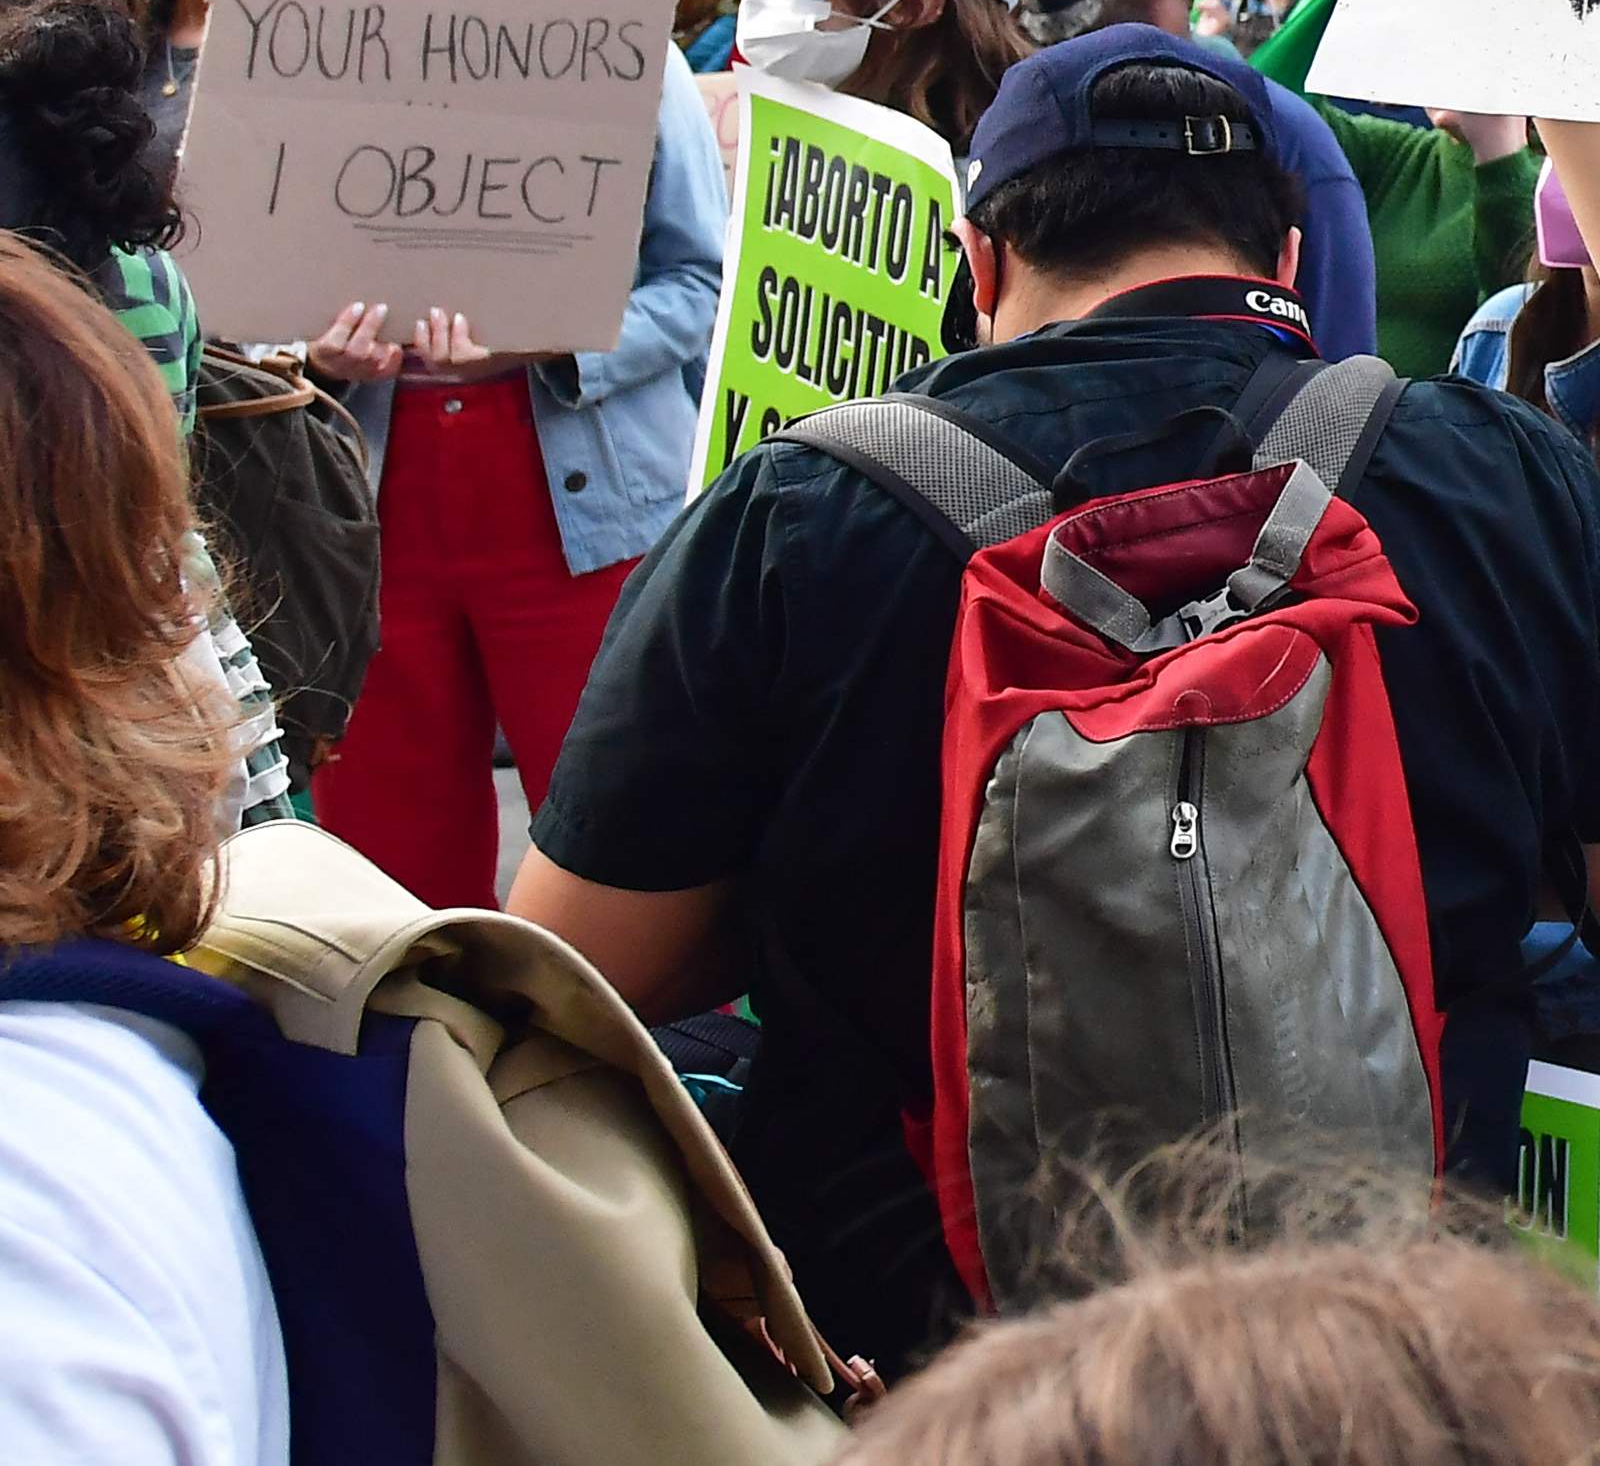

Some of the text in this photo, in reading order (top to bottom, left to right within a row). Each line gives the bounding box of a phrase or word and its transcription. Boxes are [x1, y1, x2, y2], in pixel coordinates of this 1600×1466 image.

[422, 13, 646, 82] HONORS
[269, 143, 622, 223] I OBJECT
[764, 137, 942, 300] ¡ABORTO A
